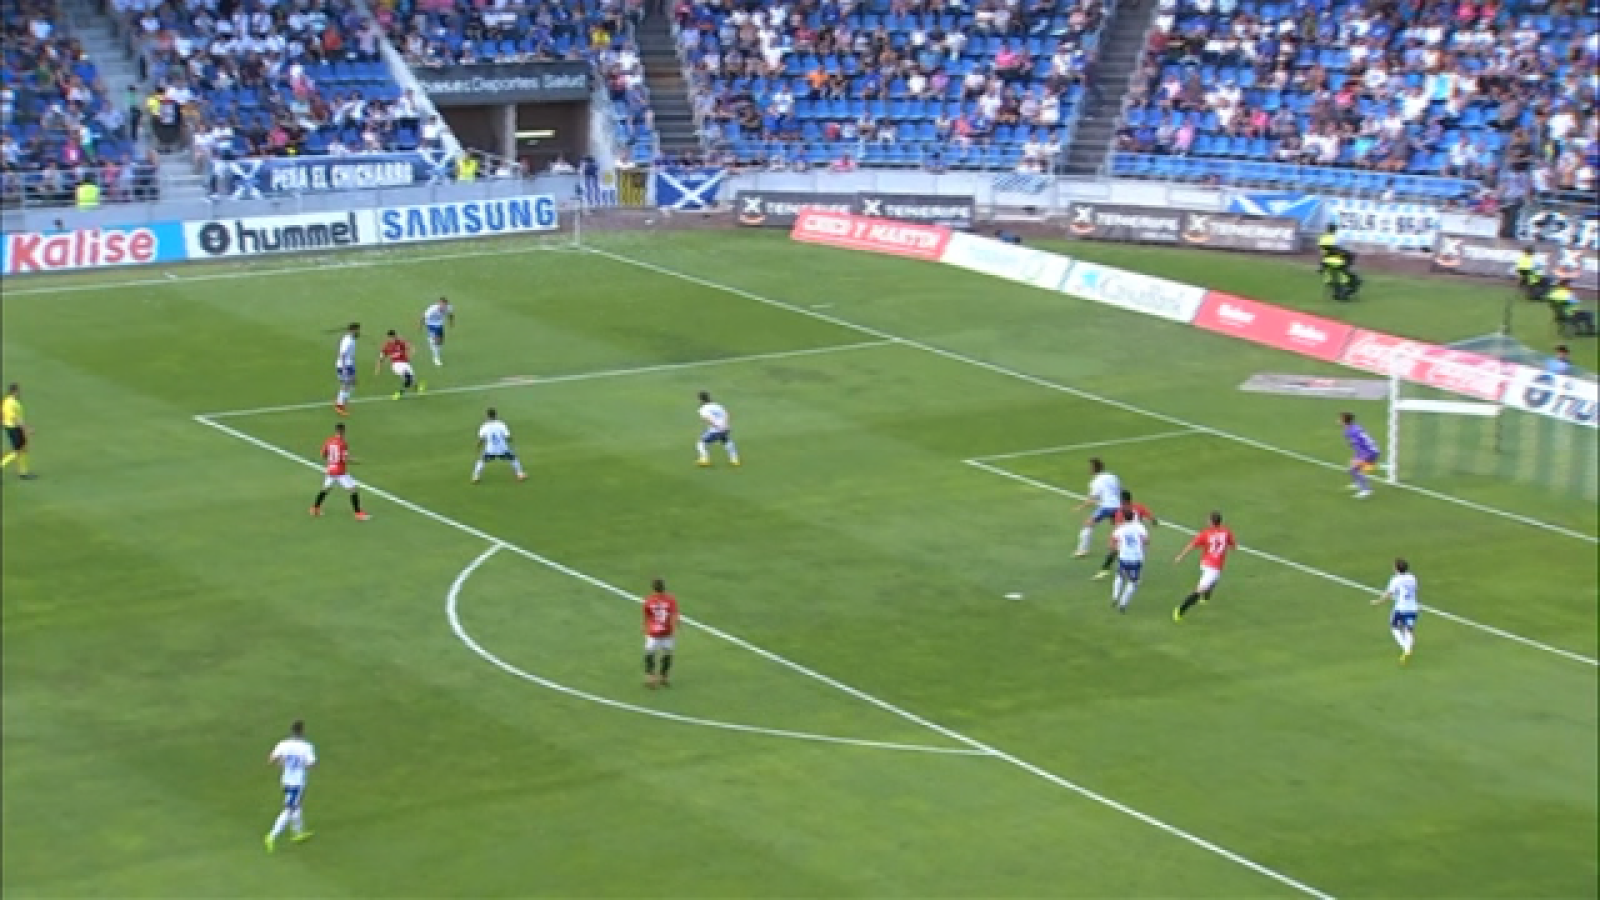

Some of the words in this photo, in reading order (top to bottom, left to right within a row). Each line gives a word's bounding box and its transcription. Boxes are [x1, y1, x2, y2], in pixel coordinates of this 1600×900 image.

[311, 165, 329, 188] EL
[237, 213, 361, 253] hummel
[382, 196, 556, 240] SAMSUNG
[8, 231, 157, 272] Kalise
